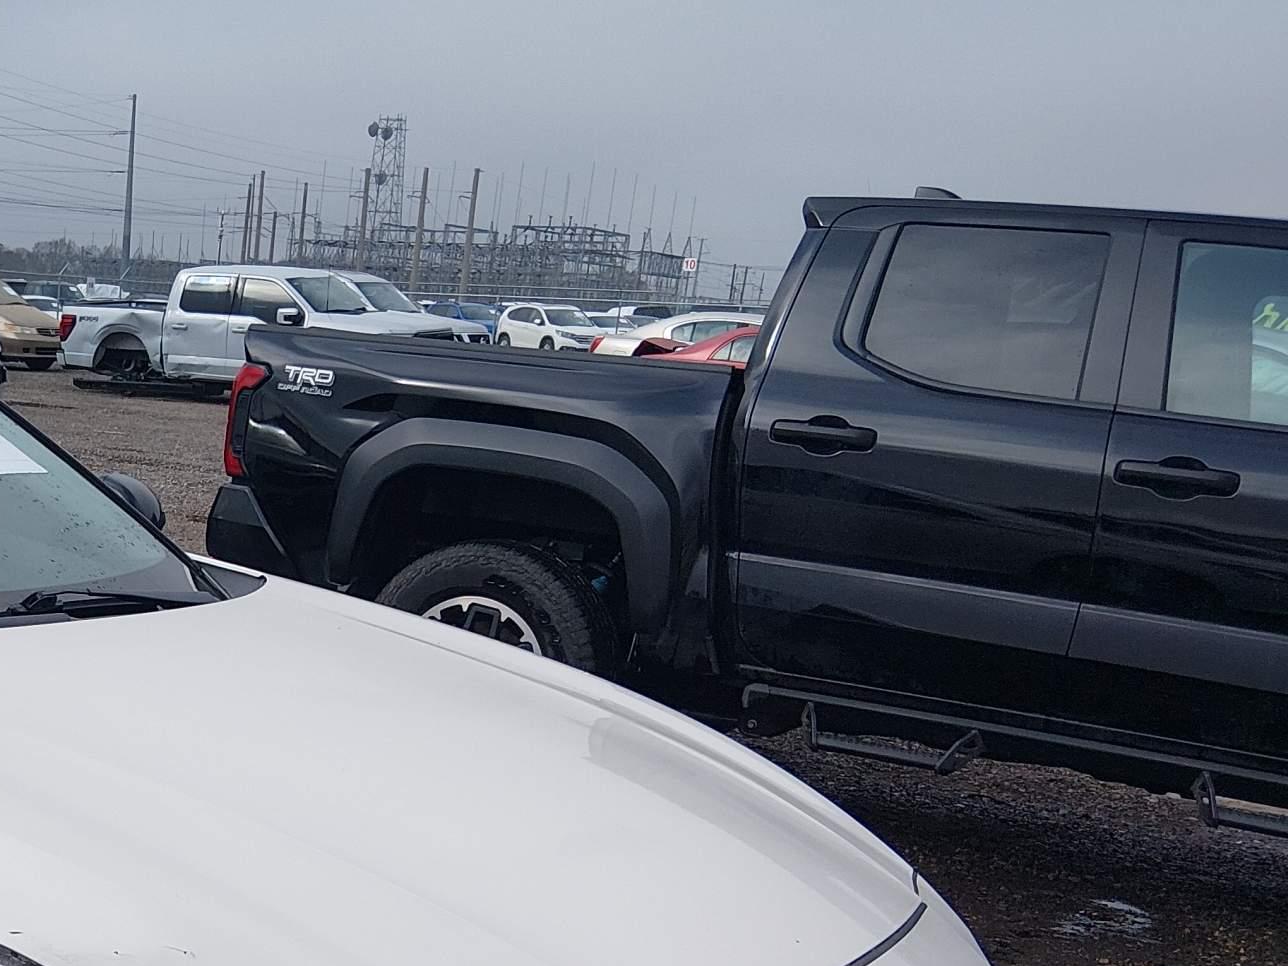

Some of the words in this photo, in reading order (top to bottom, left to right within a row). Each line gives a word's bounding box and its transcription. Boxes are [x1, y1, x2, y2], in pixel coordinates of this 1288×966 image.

[684, 259, 696, 270] 10
[284, 364, 335, 386] TRD
[300, 385, 332, 397] ROAD
